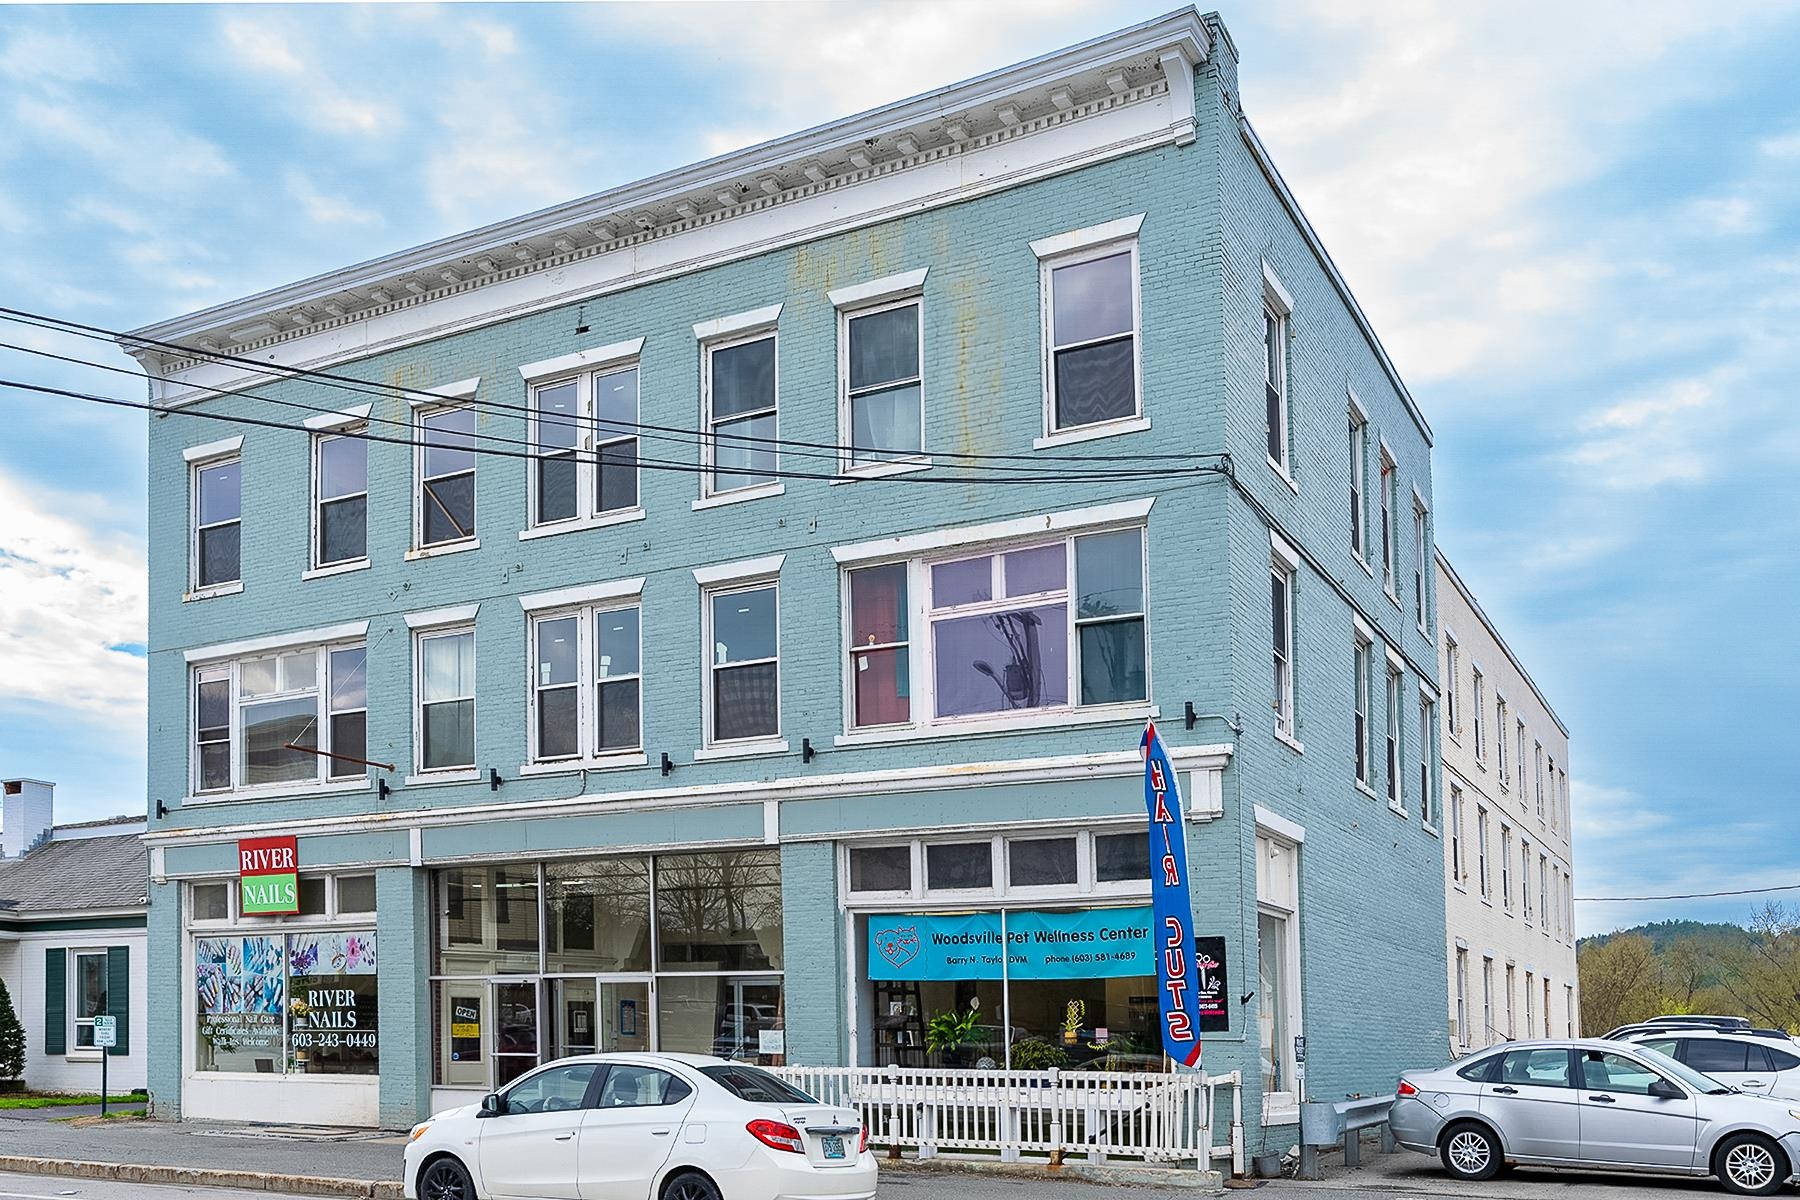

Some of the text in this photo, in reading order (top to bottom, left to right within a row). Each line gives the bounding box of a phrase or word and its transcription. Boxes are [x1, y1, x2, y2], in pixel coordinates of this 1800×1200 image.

[241, 847, 295, 871] RIVER
[243, 883, 295, 905] NAILS
[931, 926, 1149, 945] Woodsville Pet Wellness Center
[946, 955, 1028, 966] Barry N. Taylo DVM
[1045, 951, 1136, 965] phone (603) 581-4689
[308, 989, 356, 1008] RIVER
[206, 1014, 275, 1024] Professional Nail Care
[308, 1010, 357, 1028] NAILS
[457, 1007, 476, 1018] OPEN
[201, 1026, 213, 1035] Gift
[292, 1032, 376, 1047] 603-243-0449
